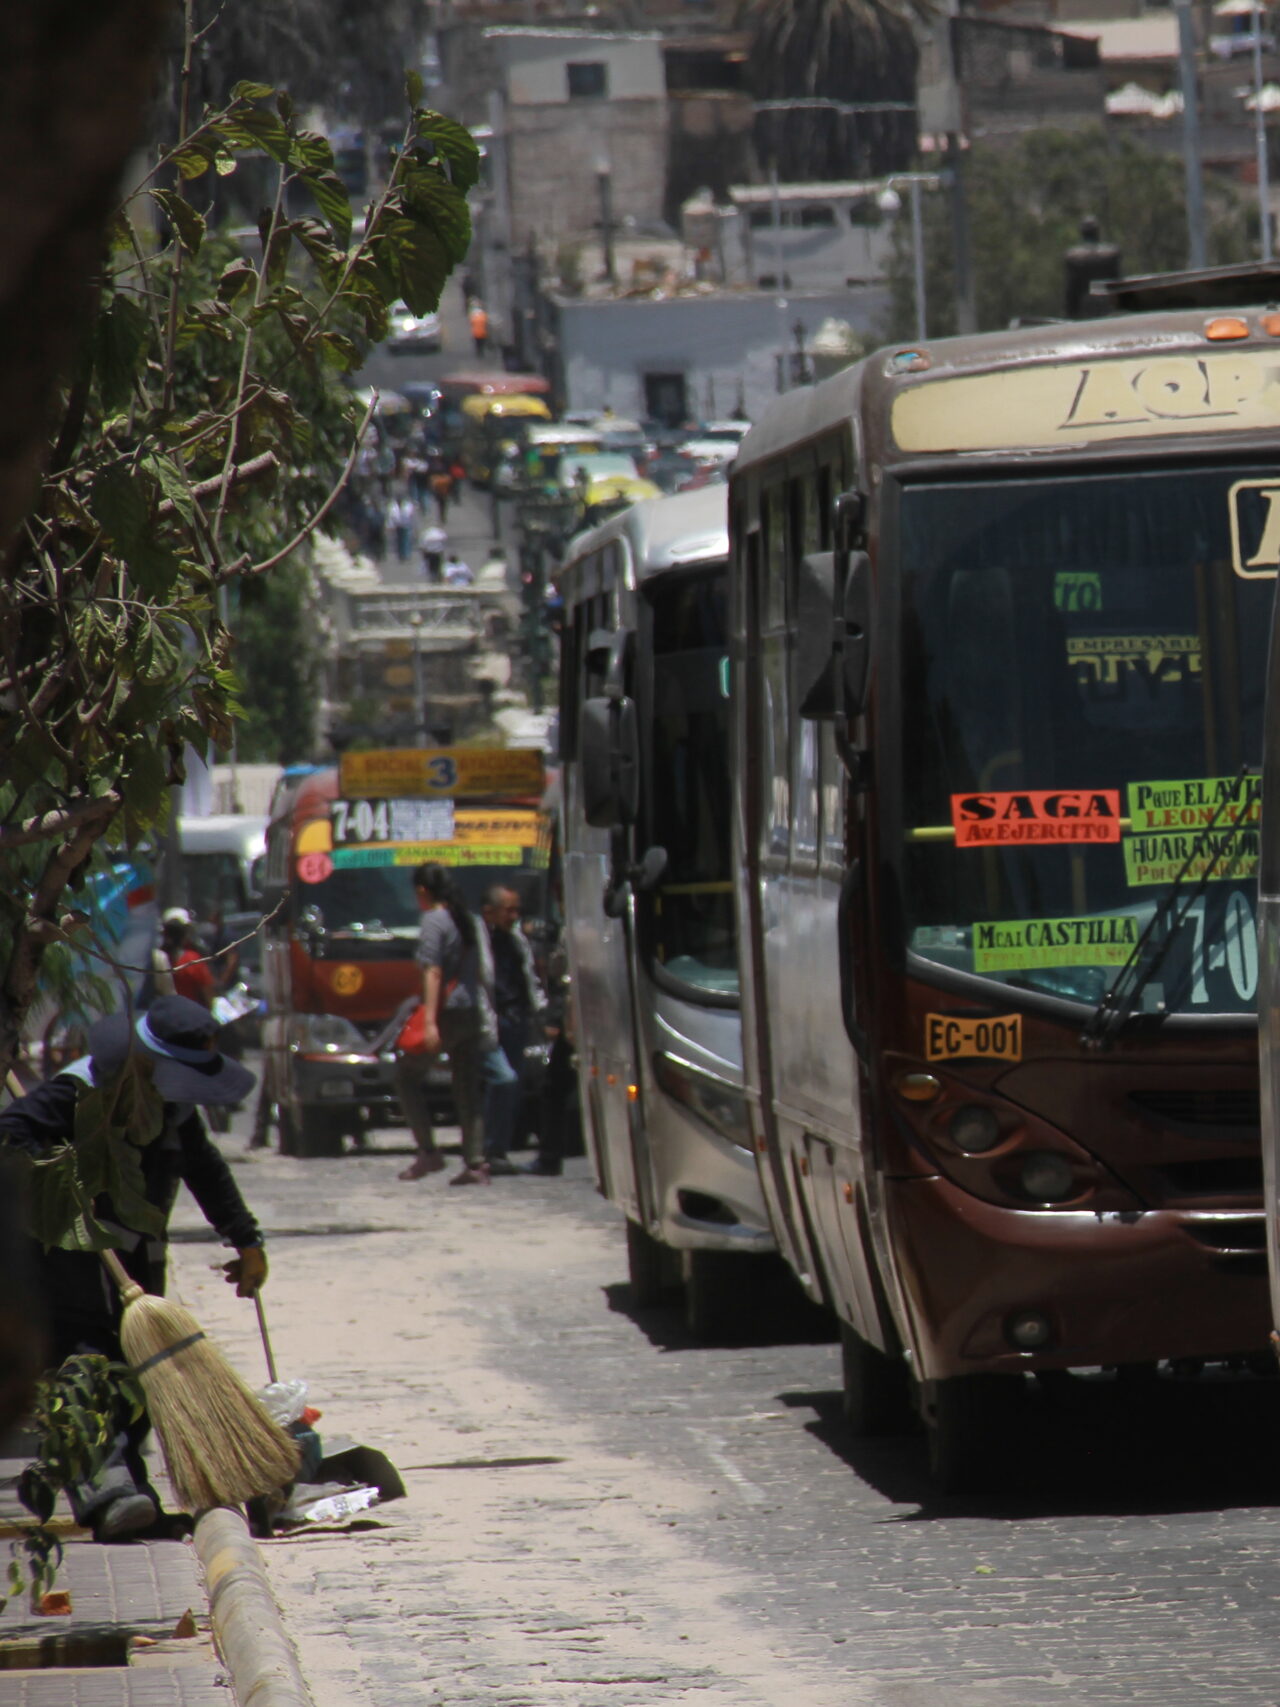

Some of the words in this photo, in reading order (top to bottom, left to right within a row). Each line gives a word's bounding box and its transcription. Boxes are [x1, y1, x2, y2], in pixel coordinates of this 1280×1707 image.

[427, 756, 457, 788] 3
[332, 800, 390, 842] 7-04
[959, 794, 1114, 821] SAGA
[1145, 806, 1215, 828] LEON
[997, 822, 1110, 841] EJERCITO
[1025, 919, 1136, 947] CASTILLA
[930, 1018, 1018, 1056] EC-001
